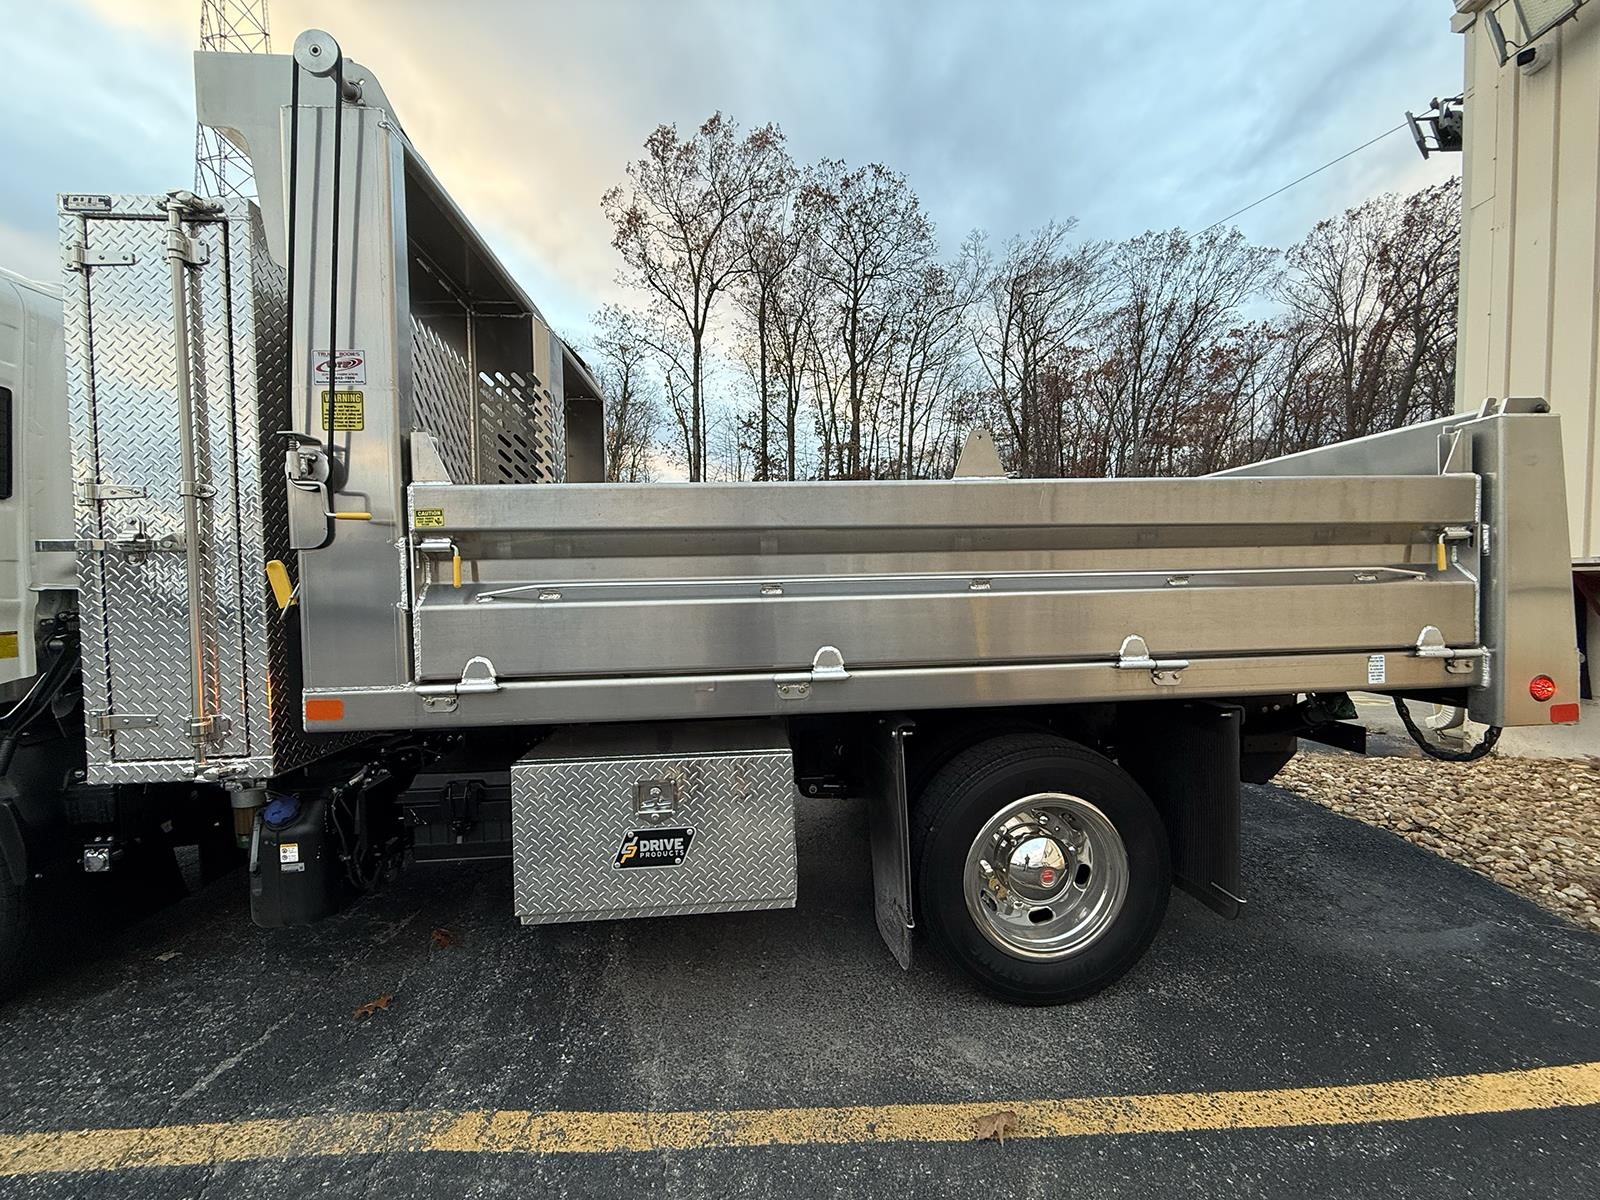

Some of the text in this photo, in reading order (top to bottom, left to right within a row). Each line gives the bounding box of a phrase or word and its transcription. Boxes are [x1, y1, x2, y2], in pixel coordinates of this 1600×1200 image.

[324, 393, 361, 402] WRNING
[640, 838, 684, 852] DRIVE
[640, 850, 684, 858] PRODUCTS
